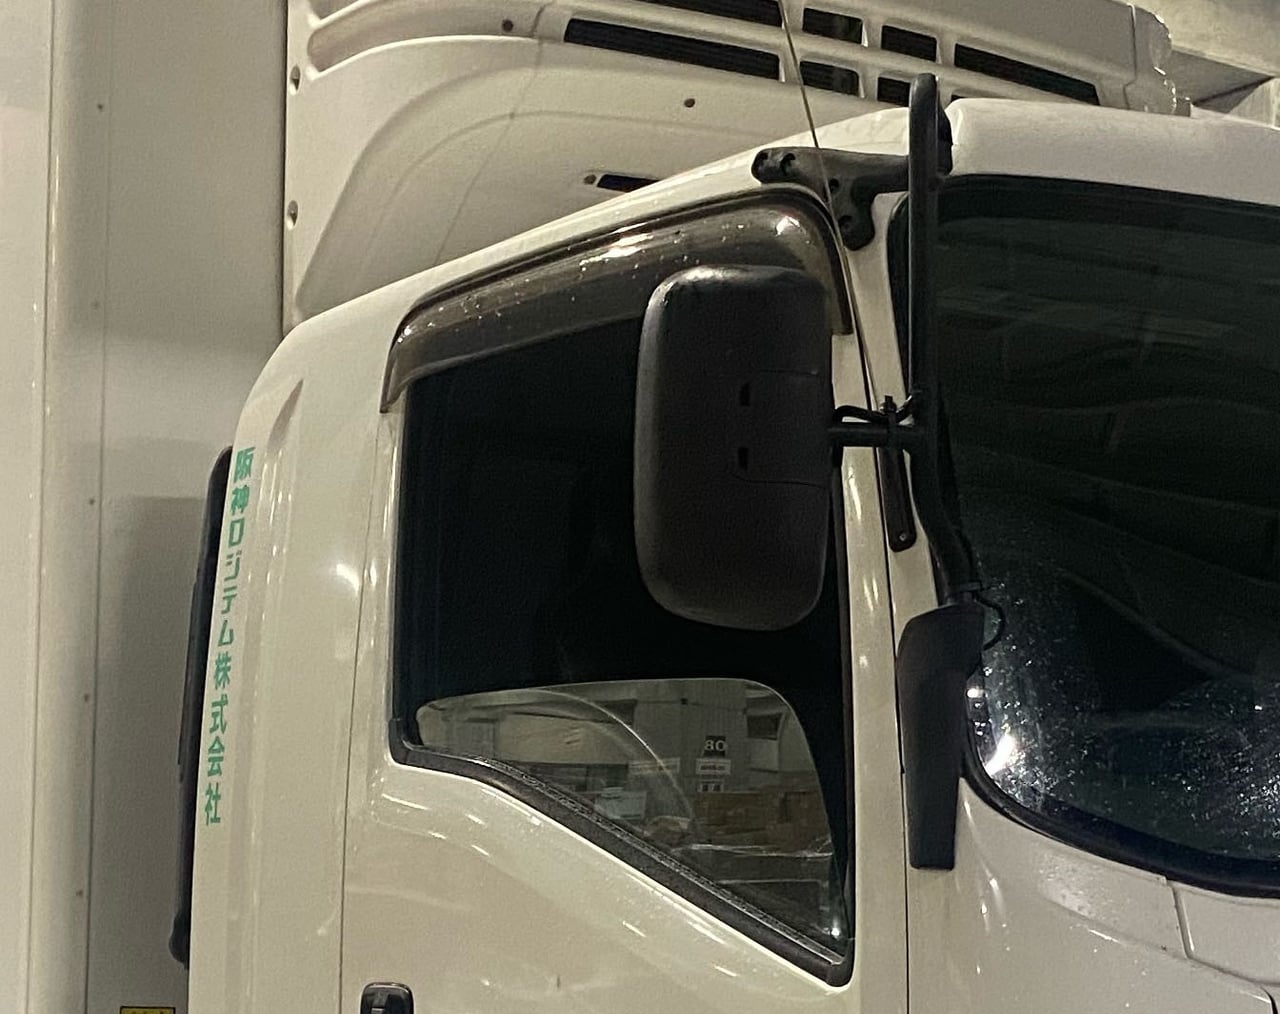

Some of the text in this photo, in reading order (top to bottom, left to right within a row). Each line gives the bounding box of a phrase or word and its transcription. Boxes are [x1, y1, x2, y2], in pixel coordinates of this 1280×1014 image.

[203, 445, 256, 827] 阪神ロジテム株式会社
